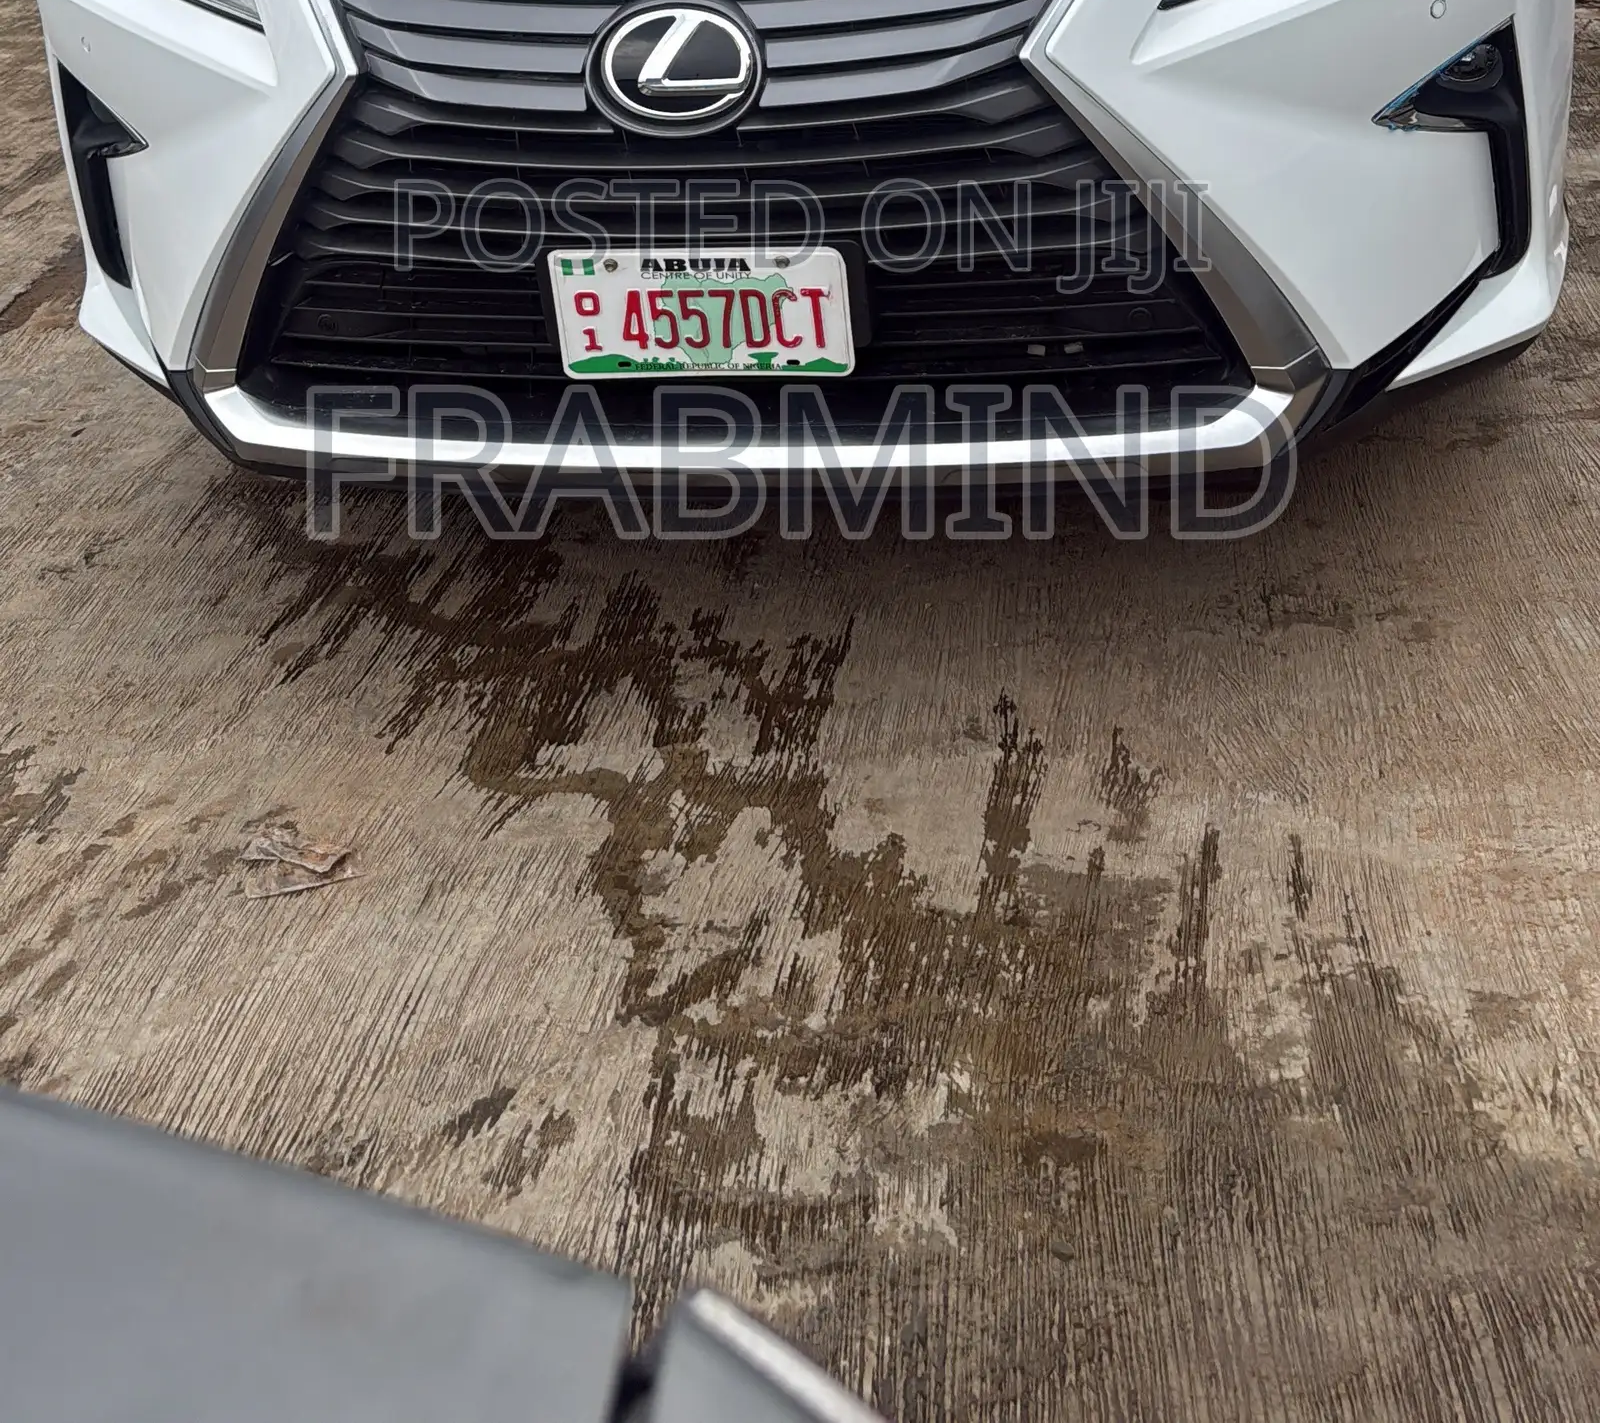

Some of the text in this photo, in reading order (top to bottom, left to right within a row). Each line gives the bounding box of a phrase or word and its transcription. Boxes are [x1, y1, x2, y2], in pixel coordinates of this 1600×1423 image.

[640, 258, 751, 272] ABUJA
[641, 271, 751, 281] CENTRE OF UNITY
[623, 289, 831, 350] 4557DCT
[634, 361, 783, 371] FEDERAL REPUBLIC OF NIGERIA
